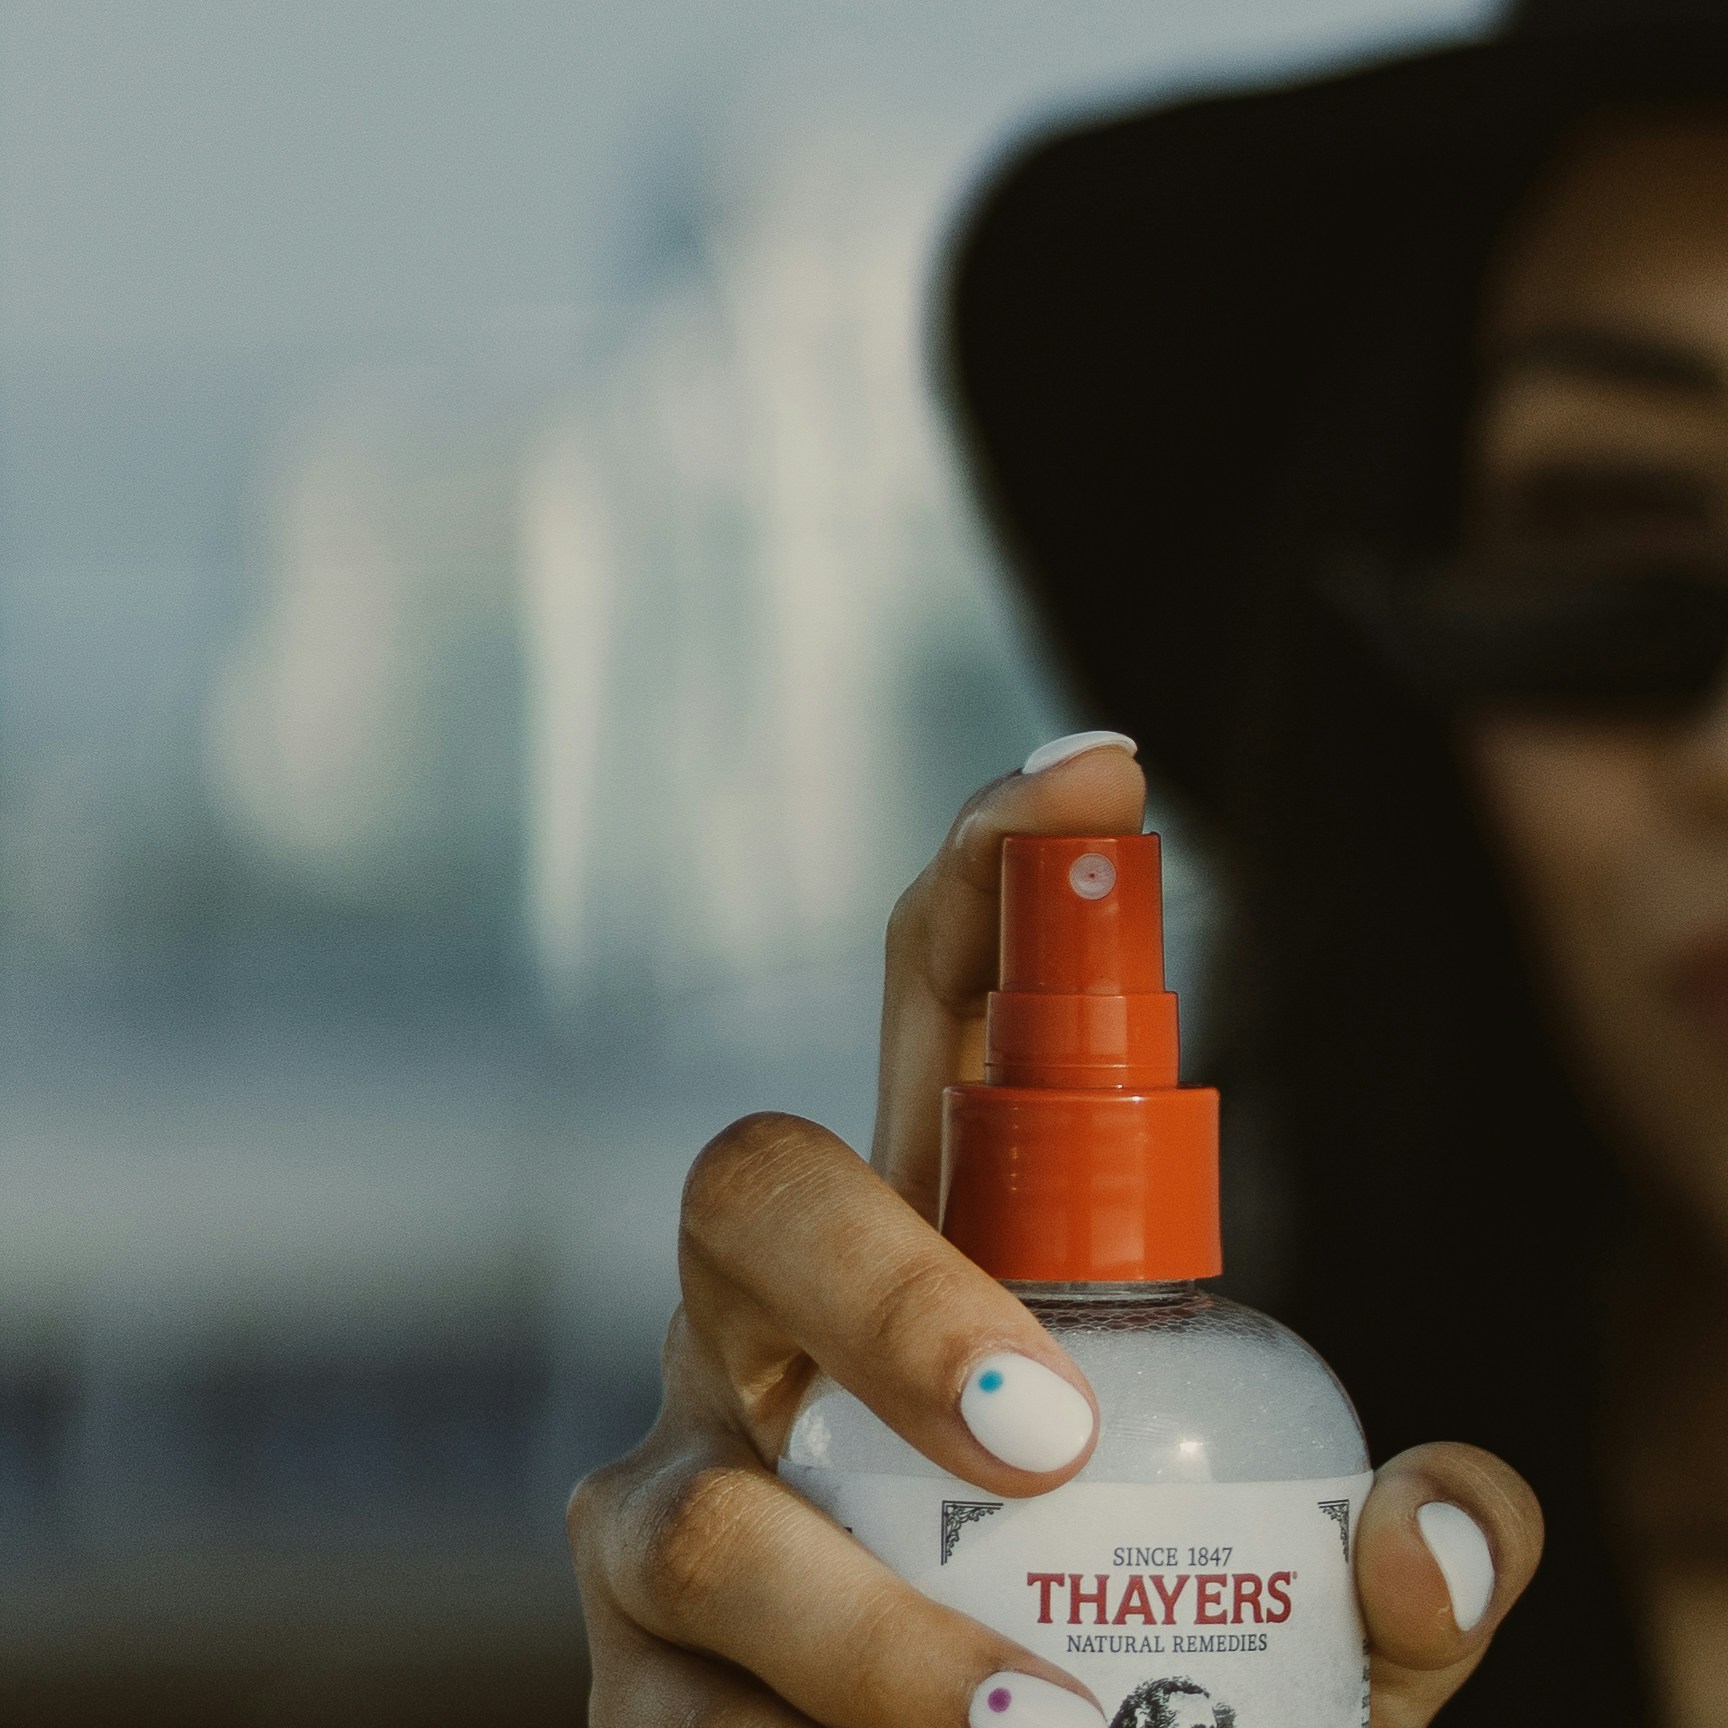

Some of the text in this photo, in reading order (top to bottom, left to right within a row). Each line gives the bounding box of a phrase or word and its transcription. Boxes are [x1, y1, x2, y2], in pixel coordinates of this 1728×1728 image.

[1113, 1546, 1232, 1567] SINCE 1847
[1027, 1571, 1293, 1625] THAYERS
[1066, 1633, 1268, 1653] NATURAL REMEDIES
